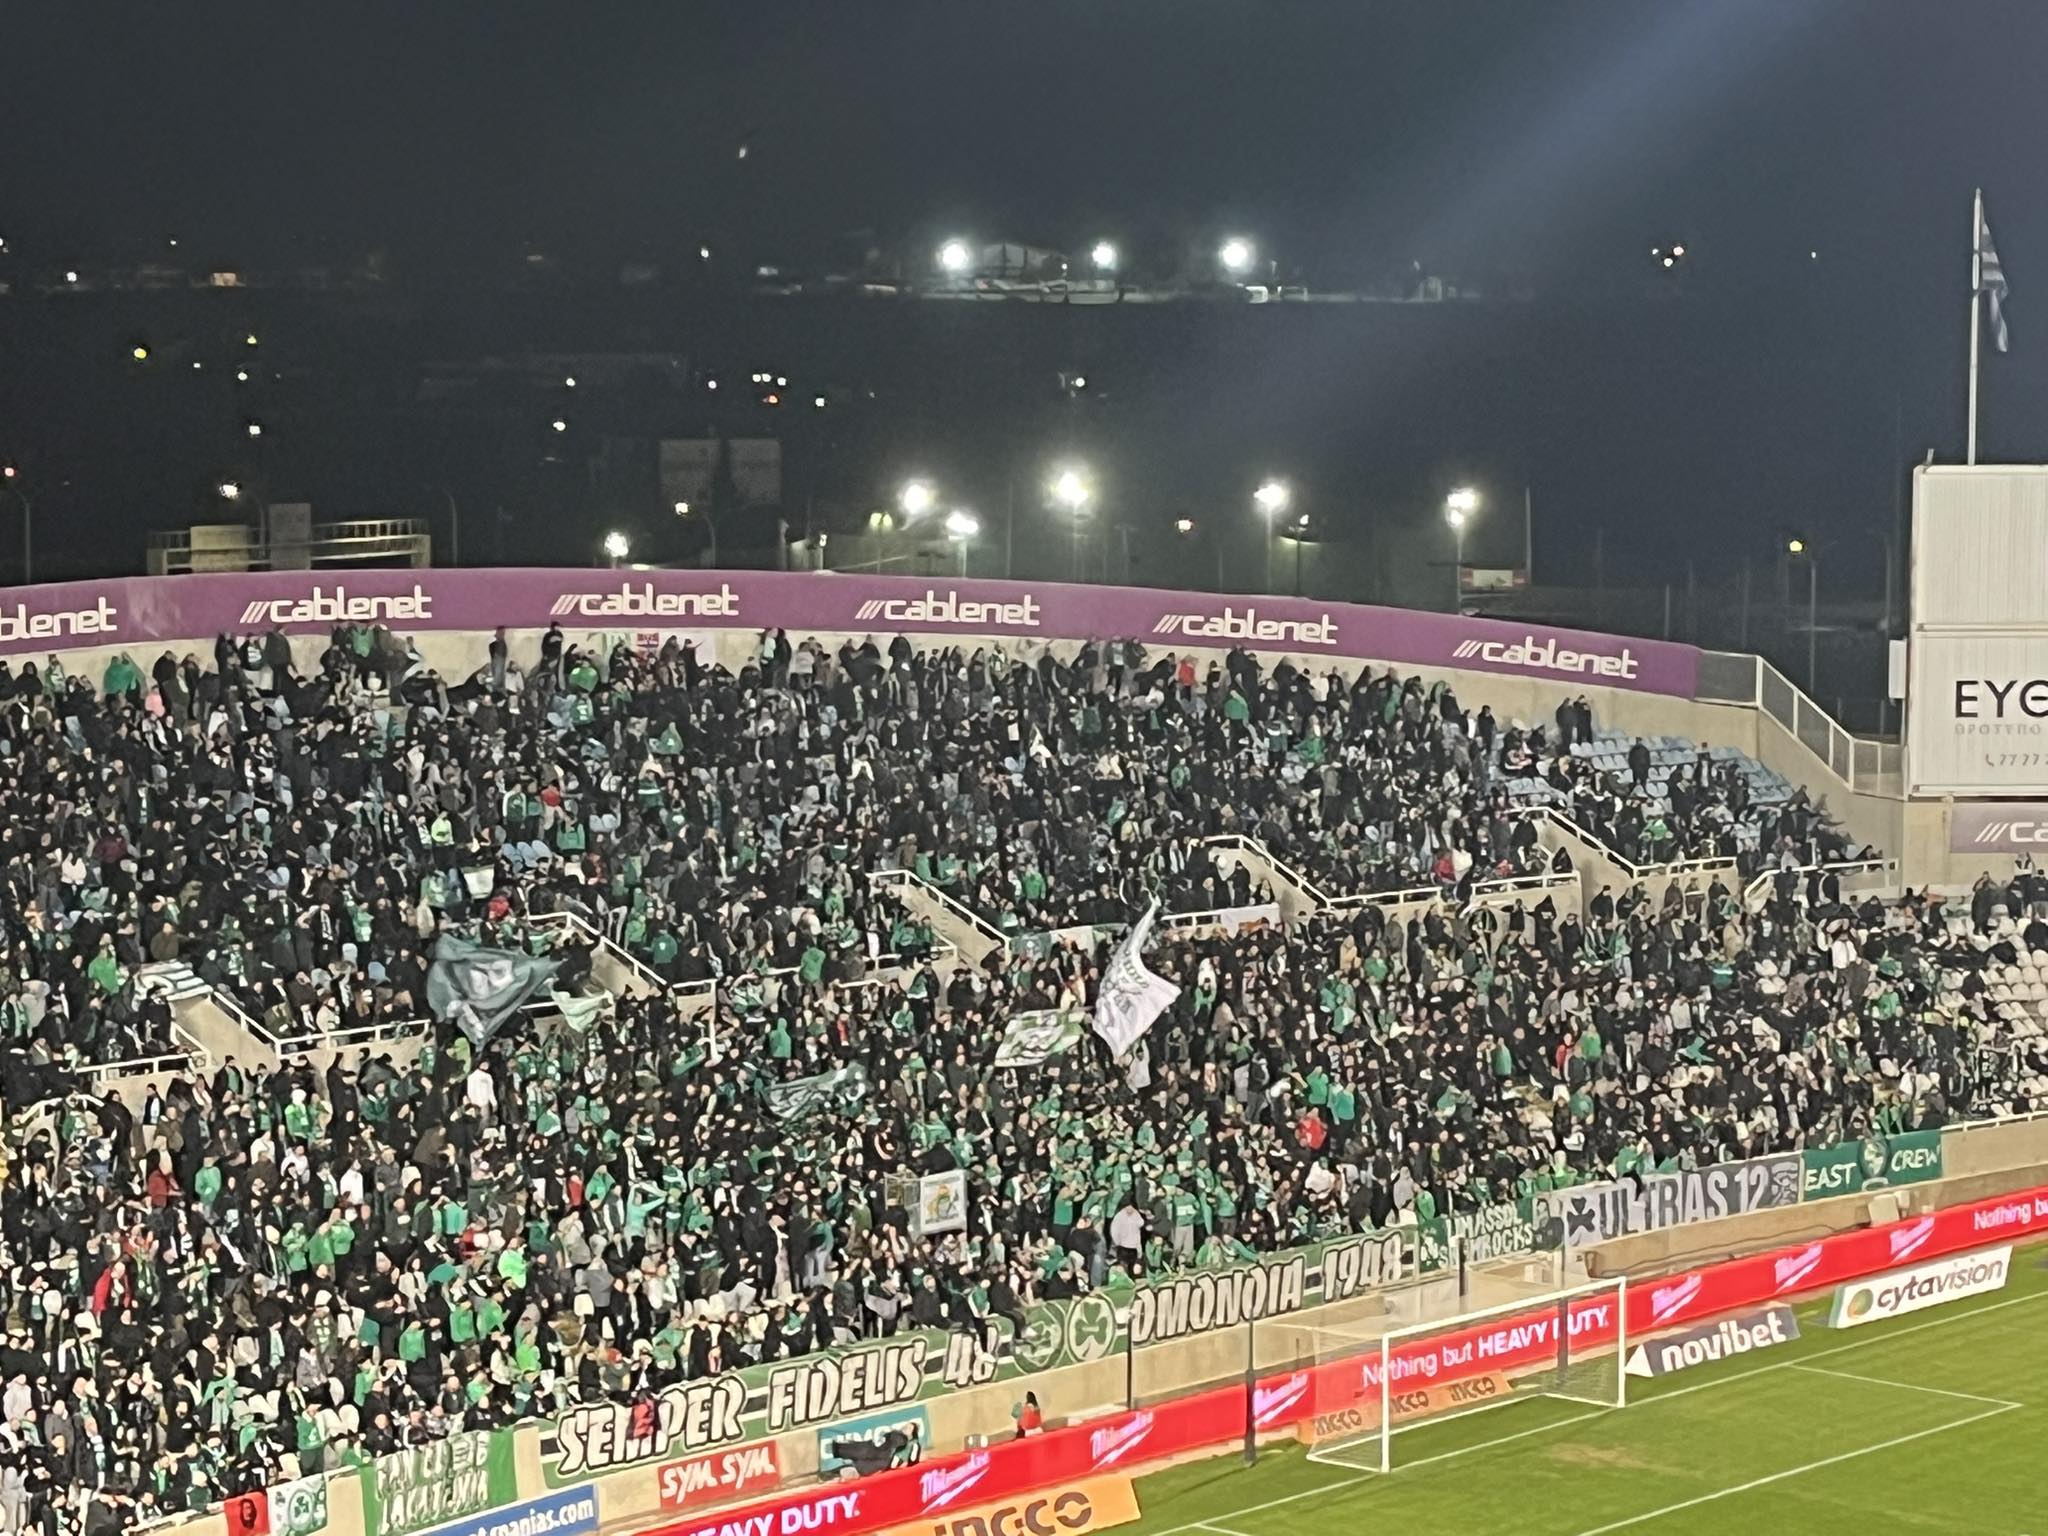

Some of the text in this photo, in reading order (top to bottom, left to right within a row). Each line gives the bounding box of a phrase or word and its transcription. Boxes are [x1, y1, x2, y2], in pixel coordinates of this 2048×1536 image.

[269, 585, 432, 623] cablenet
[580, 583, 739, 617] cablenet
[884, 590, 1041, 626] cablenet
[1181, 607, 1339, 645] cablenet
[1482, 635, 1639, 681] cablenet
[1735, 1164, 1769, 1217] 12
[1804, 1145, 1941, 1191] EAST CREW
[1130, 1232, 1403, 1343] OMONOIA 1948
[1877, 1258, 2003, 1311] cytavision
[1442, 1342, 1472, 1367] but
[1478, 1320, 1547, 1358] HEAVY
[1661, 1311, 1787, 1372] novibet
[555, 1376, 748, 1476] SEMPER
[767, 1338, 928, 1430] FIDELIS
[661, 1446, 776, 1504] SYM SYM
